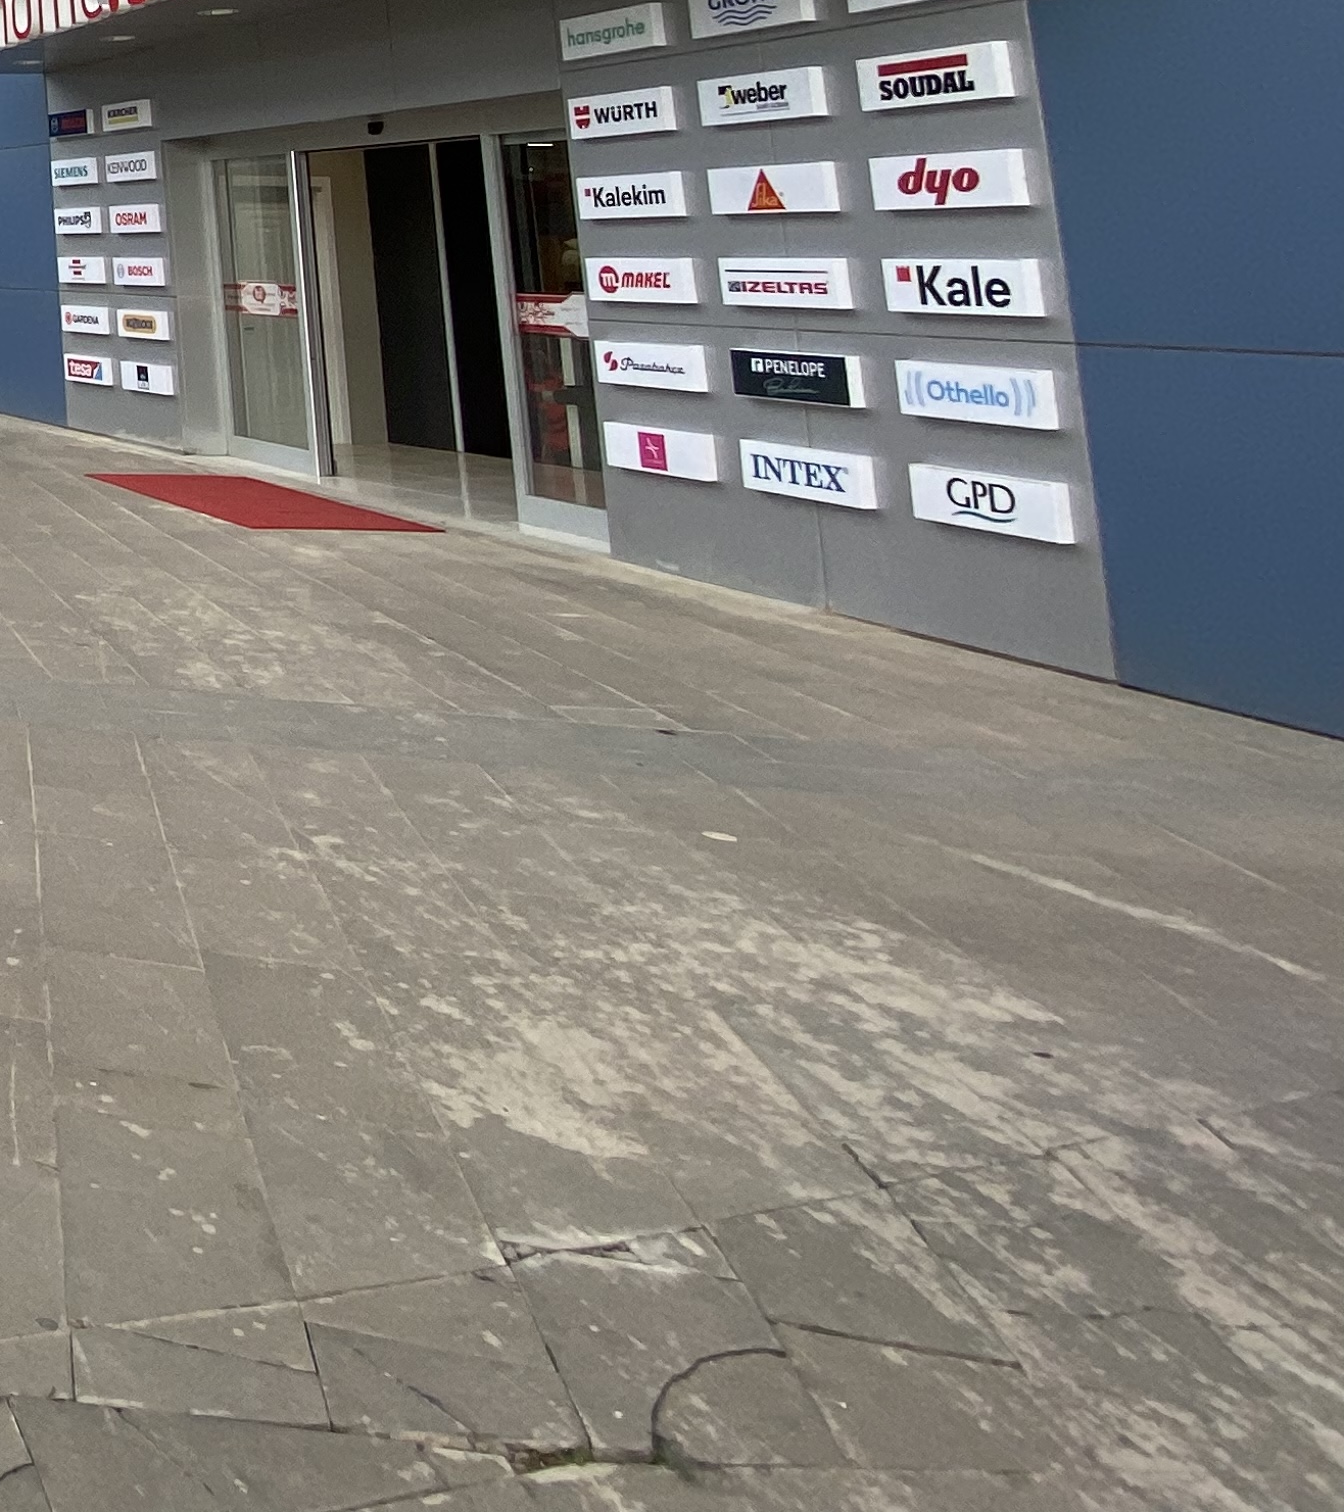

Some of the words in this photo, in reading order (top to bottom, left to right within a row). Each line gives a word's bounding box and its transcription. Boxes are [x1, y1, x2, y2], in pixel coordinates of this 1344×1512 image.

[567, 18, 646, 47] hansgrohe
[731, 81, 787, 104] weber
[879, 70, 975, 101] SOUDAL
[594, 100, 658, 125] WÜRTH
[54, 165, 88, 180] SIEMENS
[107, 159, 147, 175] KENWOOD
[898, 157, 980, 206] dyo
[593, 184, 666, 209] Kalekim
[58, 215, 84, 226] PHILIPS
[115, 212, 147, 226] OSRAM
[127, 265, 153, 276] BOSCH
[621, 271, 670, 289] MAKEL
[916, 266, 1011, 308] Kale
[73, 314, 99, 325] GARDENA
[69, 360, 92, 377] tesa
[765, 358, 826, 378] PENELOPE
[926, 381, 1009, 408] Othello
[752, 454, 846, 493] INTEX
[947, 478, 1016, 515] GPD
